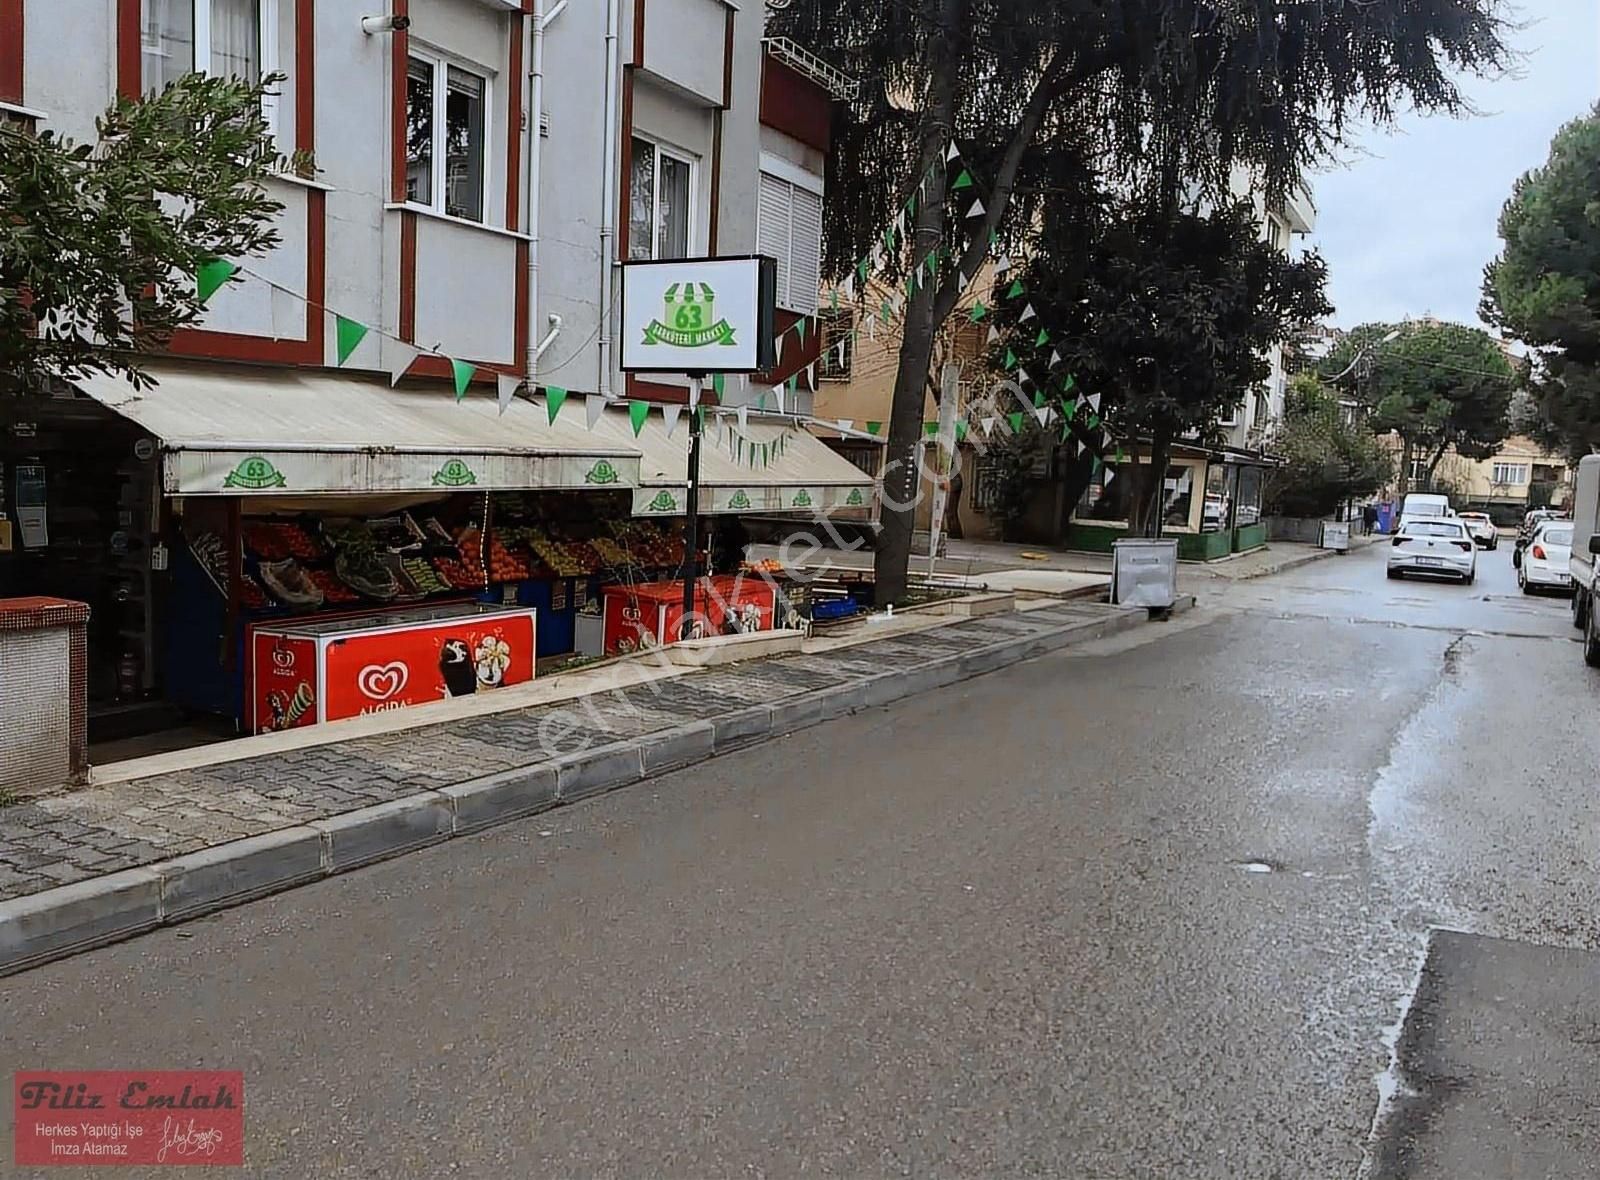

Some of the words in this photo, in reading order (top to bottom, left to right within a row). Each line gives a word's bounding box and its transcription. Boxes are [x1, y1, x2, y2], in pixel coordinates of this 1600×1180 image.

[675, 305, 702, 328] 63
[247, 461, 266, 477] 63
[448, 463, 462, 476] 63
[360, 699, 407, 717] ALGIDA
